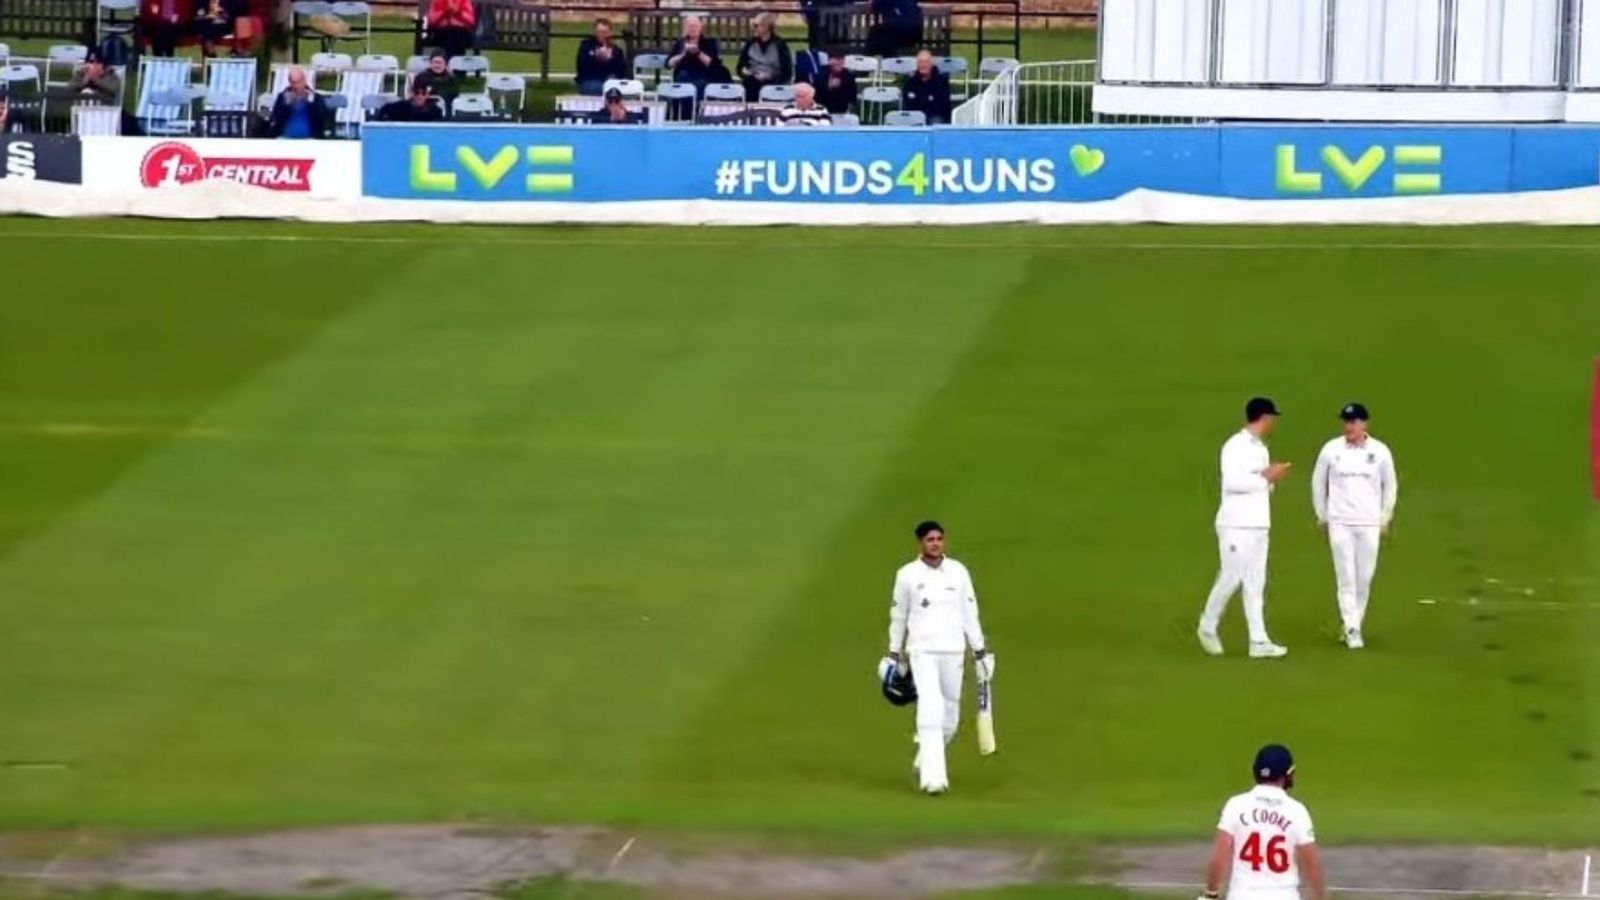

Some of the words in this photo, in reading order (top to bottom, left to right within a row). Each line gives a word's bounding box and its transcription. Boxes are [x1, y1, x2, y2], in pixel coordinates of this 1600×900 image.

[208, 164, 304, 185] CENTRAL
[715, 152, 1056, 196] #FUNDS4RUNS
[1239, 812, 1249, 826] C
[1239, 831, 1290, 874] 46
